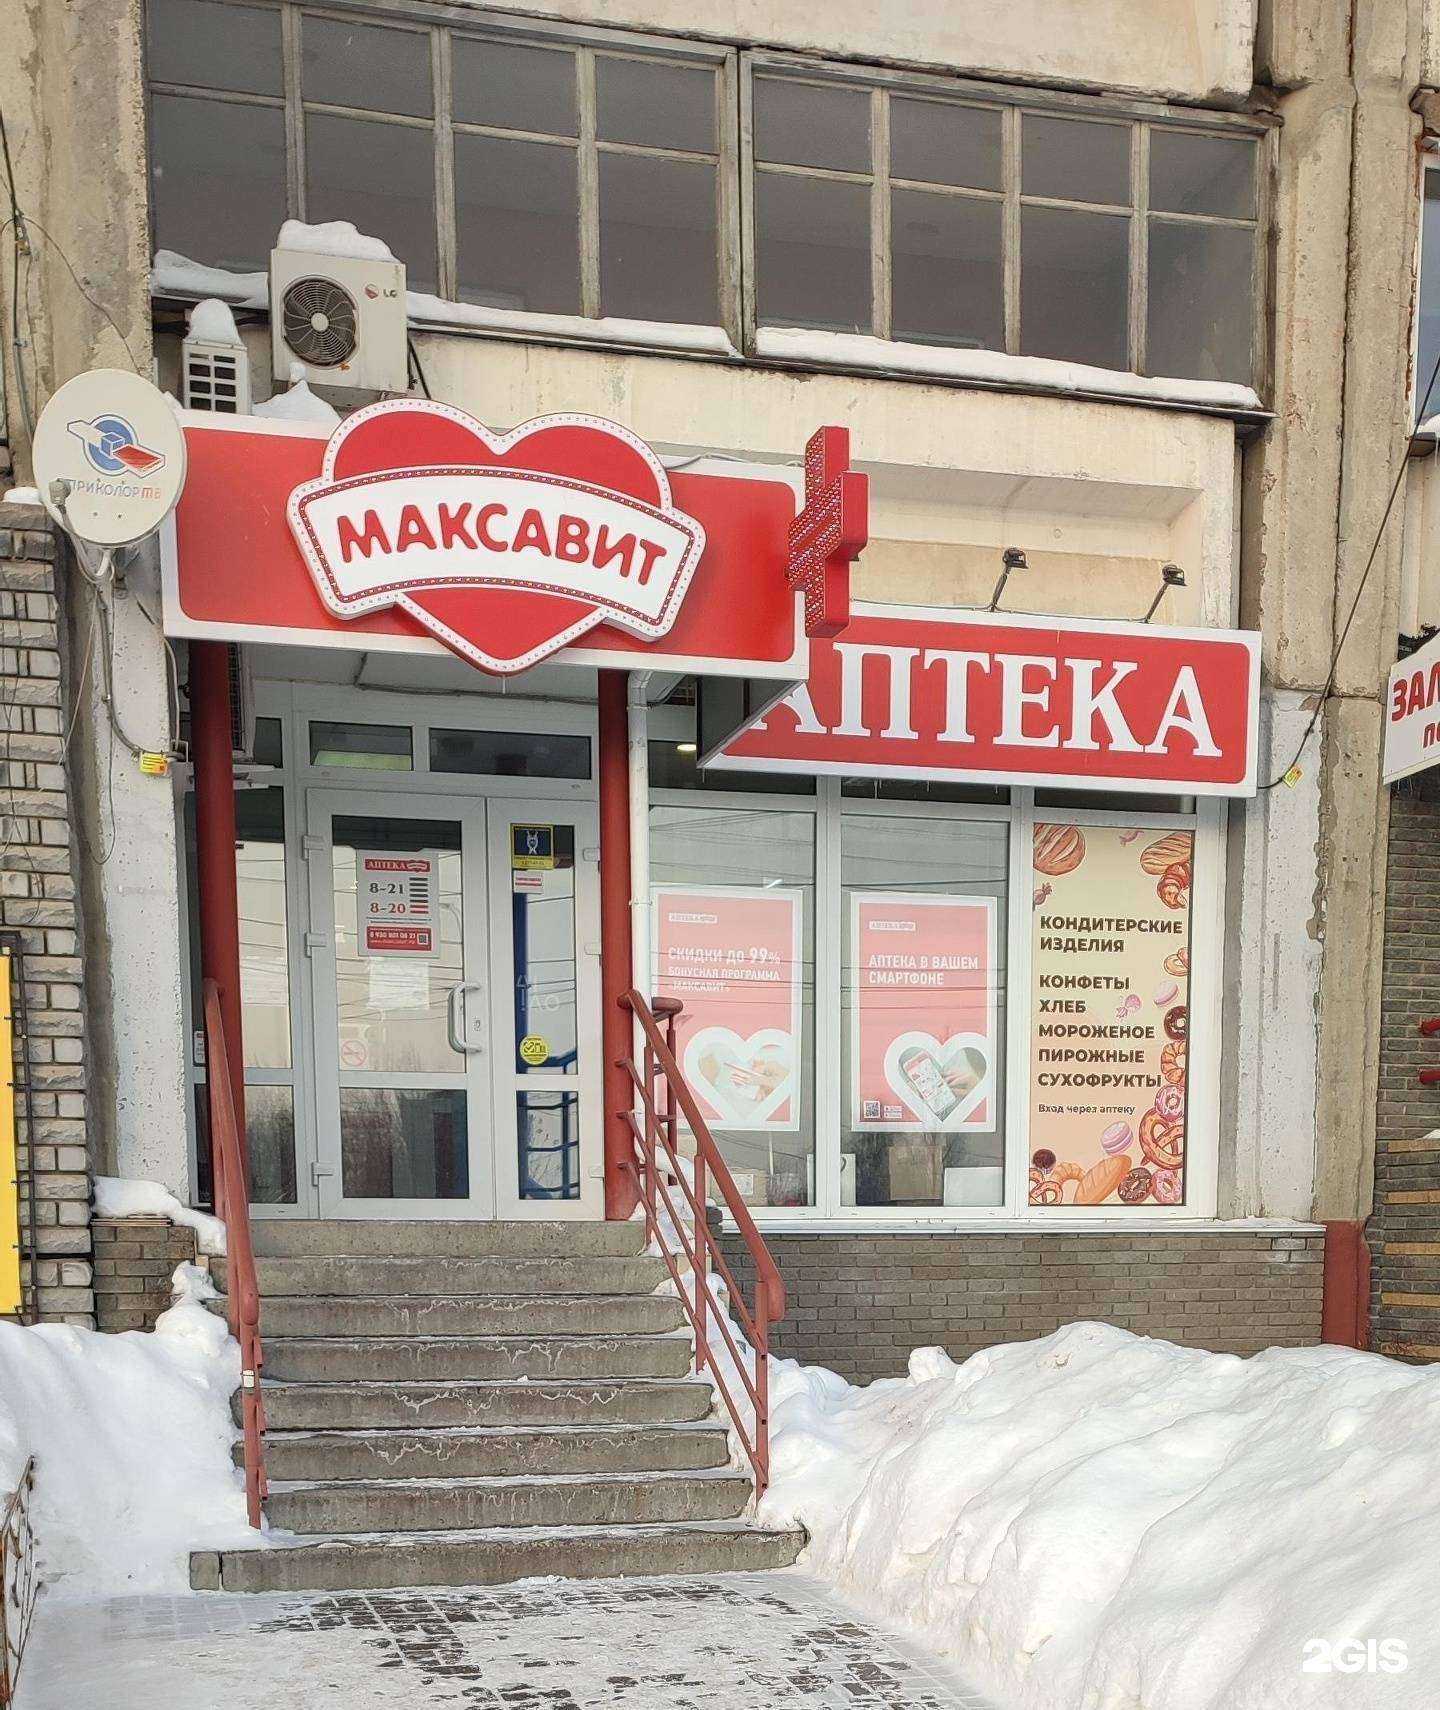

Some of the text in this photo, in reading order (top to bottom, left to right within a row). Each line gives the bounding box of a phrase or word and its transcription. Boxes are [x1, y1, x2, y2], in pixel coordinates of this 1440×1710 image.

[383, 289, 397, 298] LG
[337, 502, 667, 585] МАКСАВИТ
[368, 860, 406, 870] АПТЕКА
[369, 882, 404, 894] 8-21
[370, 902, 406, 914] 8-20
[1040, 915, 1183, 935] КОНДИТЕРСКИЕ
[1040, 937, 1125, 953] ИЗДЕЛИЯ
[668, 947, 782, 964] СКИДКИ ДО 99%
[868, 954, 979, 970] АПТЕКА В ВАШЕМ
[869, 971, 945, 986] СМАРТФОНЕ
[1039, 974, 1130, 990] КОНФЕТЫ
[1039, 999, 1087, 1014] ХЛЕБ
[1038, 1023, 1155, 1039] МОРОЖЕНОЕ
[1038, 1048, 1145, 1064] ПИРОЖНЫЕ
[1037, 1072, 1162, 1088] СУХОФРУКТЫ
[1038, 1103, 1136, 1115] Вход через аптеку
